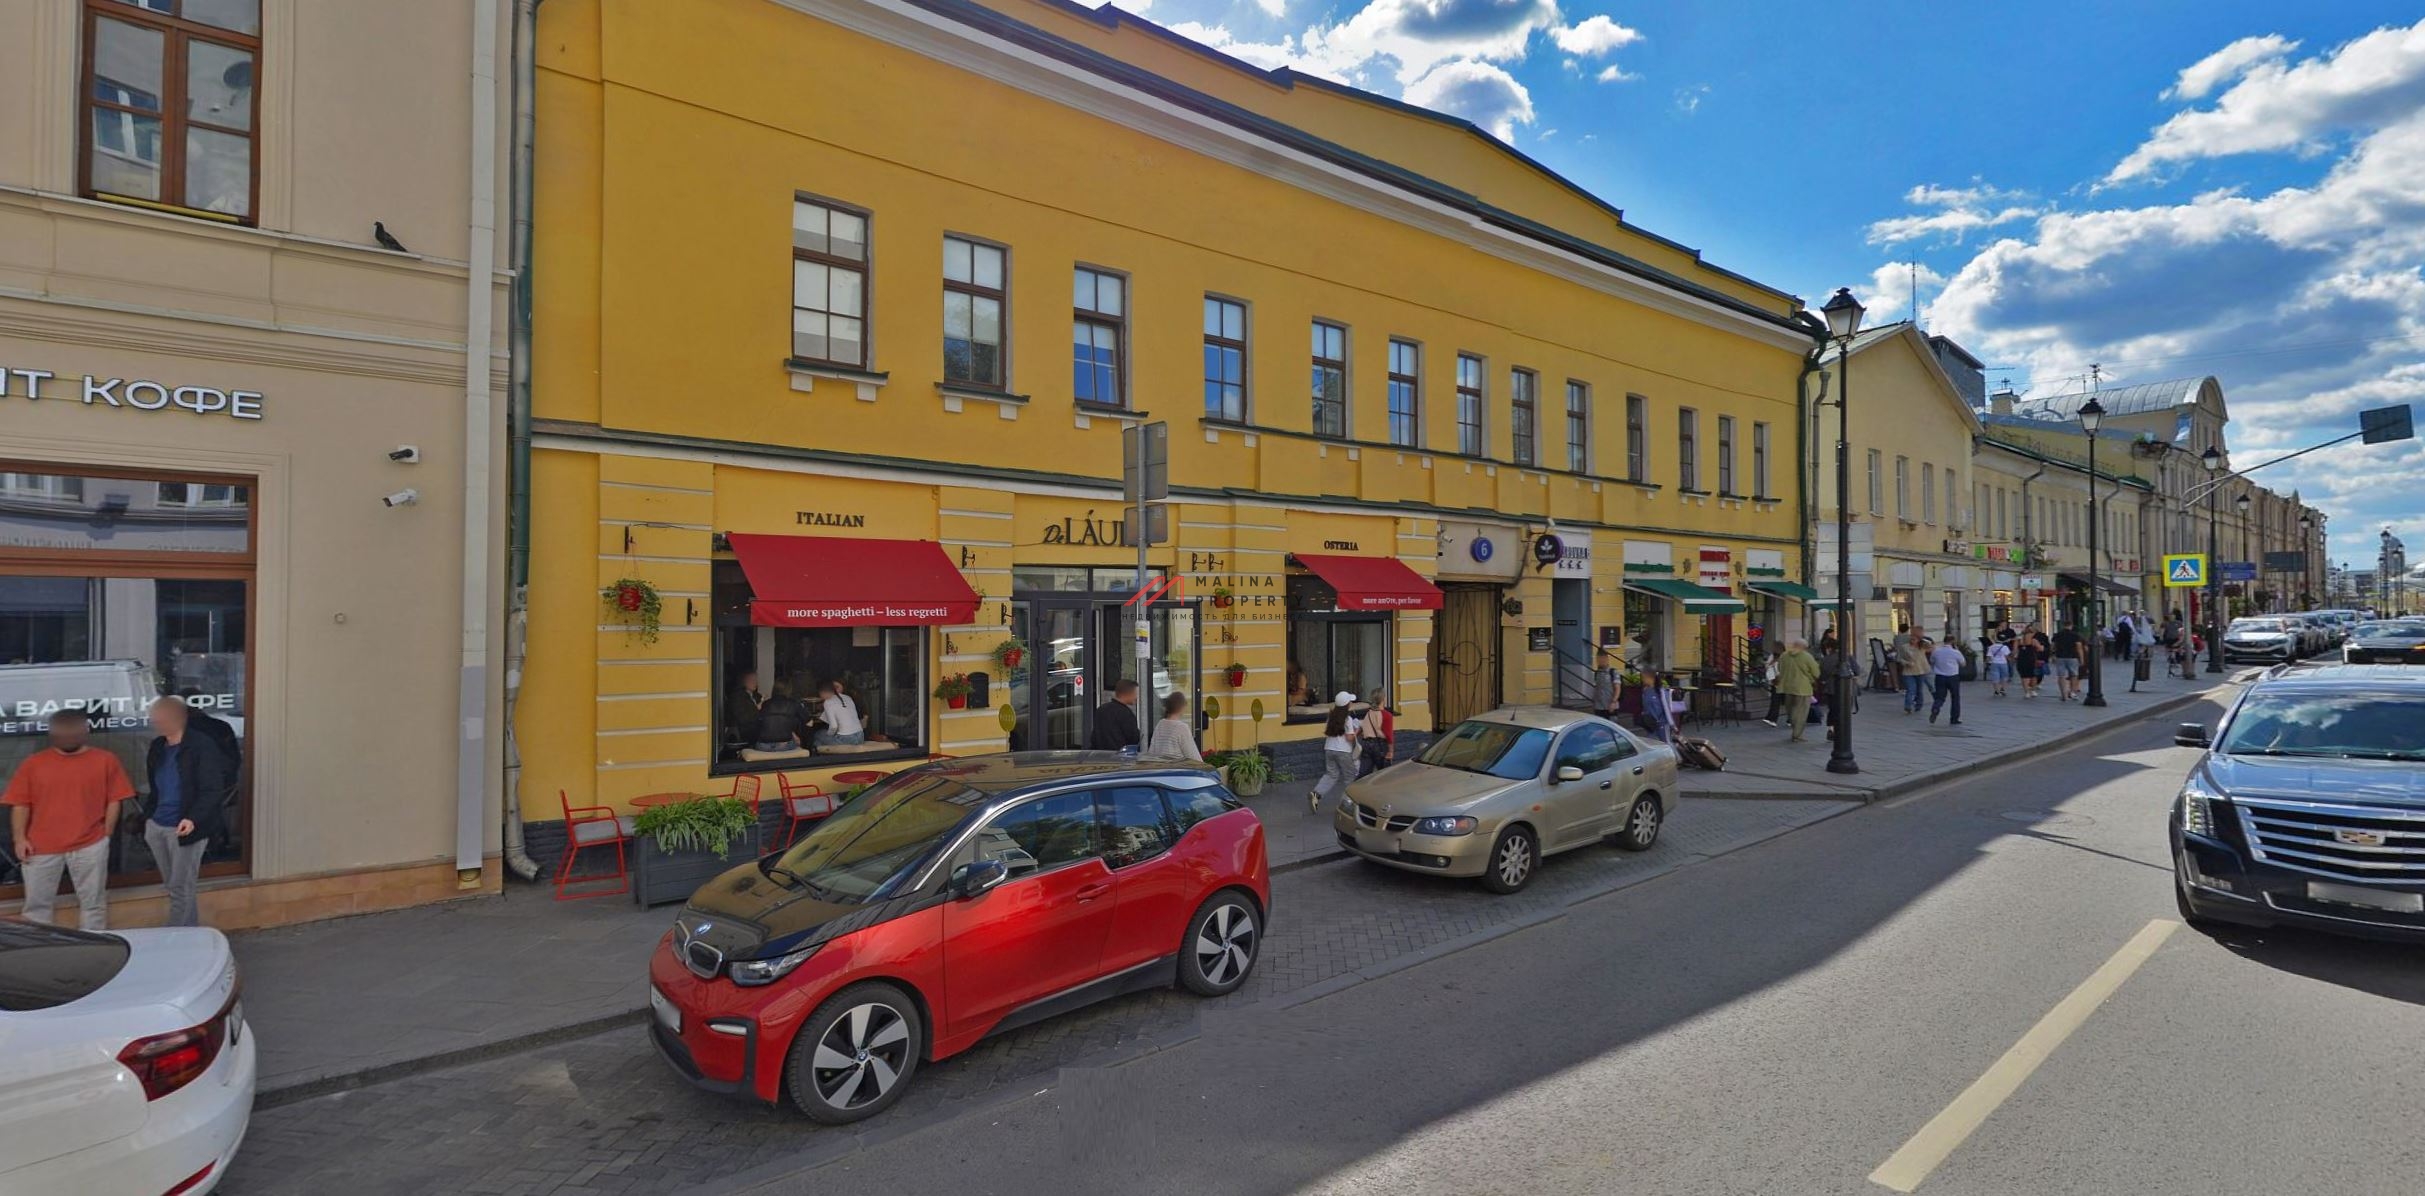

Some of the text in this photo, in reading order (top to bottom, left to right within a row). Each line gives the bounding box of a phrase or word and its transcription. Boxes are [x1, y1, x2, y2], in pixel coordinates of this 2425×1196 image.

[82, 375, 264, 420] КОФЕ
[796, 511, 865, 528] ITALIAN
[1324, 540, 1360, 551] OSTERIA
[1481, 543, 1488, 556] 6
[787, 608, 819, 618] more
[821, 606, 875, 619] spaghetti
[886, 606, 906, 617] less
[908, 607, 948, 619] regretti
